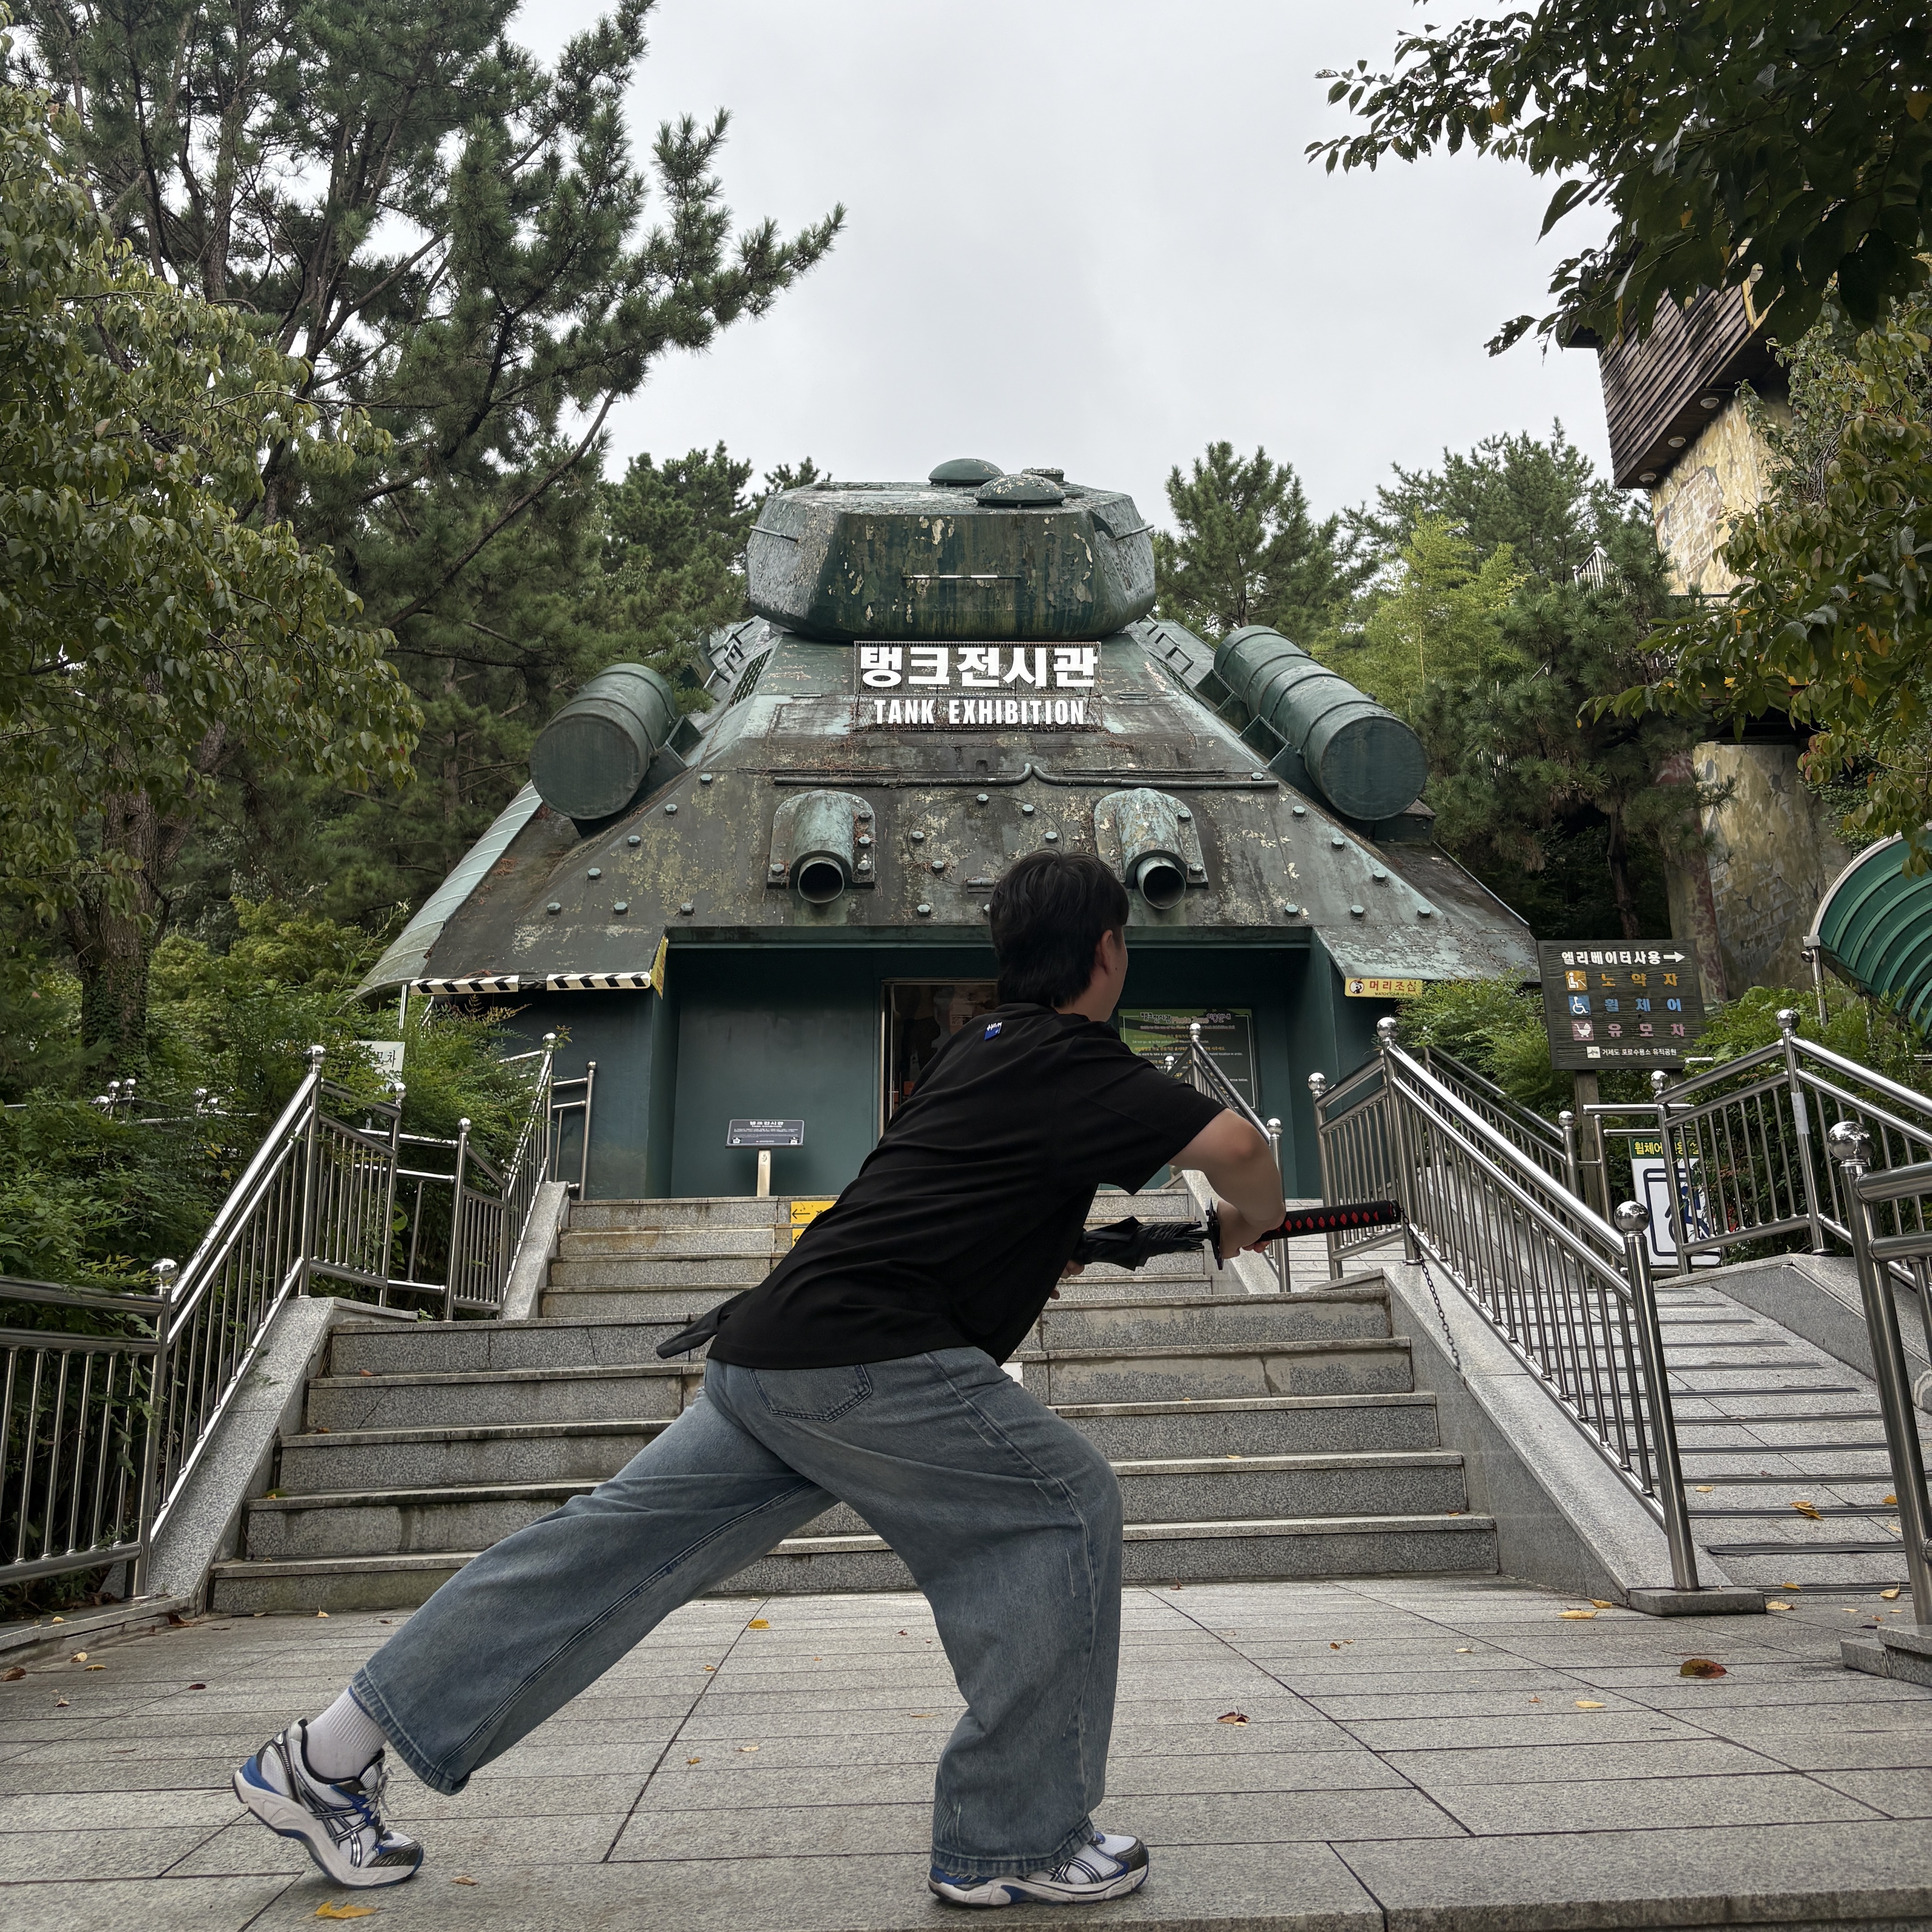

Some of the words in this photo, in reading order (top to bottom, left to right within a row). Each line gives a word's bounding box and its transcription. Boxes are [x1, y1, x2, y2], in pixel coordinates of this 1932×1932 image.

[860, 647, 1098, 687] 탱크전시관
[874, 699, 935, 724] TANK
[949, 699, 1084, 725] EXHIBITION
[1561, 951, 1661, 965] 엘리베이터사용
[1369, 980, 1416, 992] 머리조심
[1634, 1141, 1664, 1155] 휠체어
